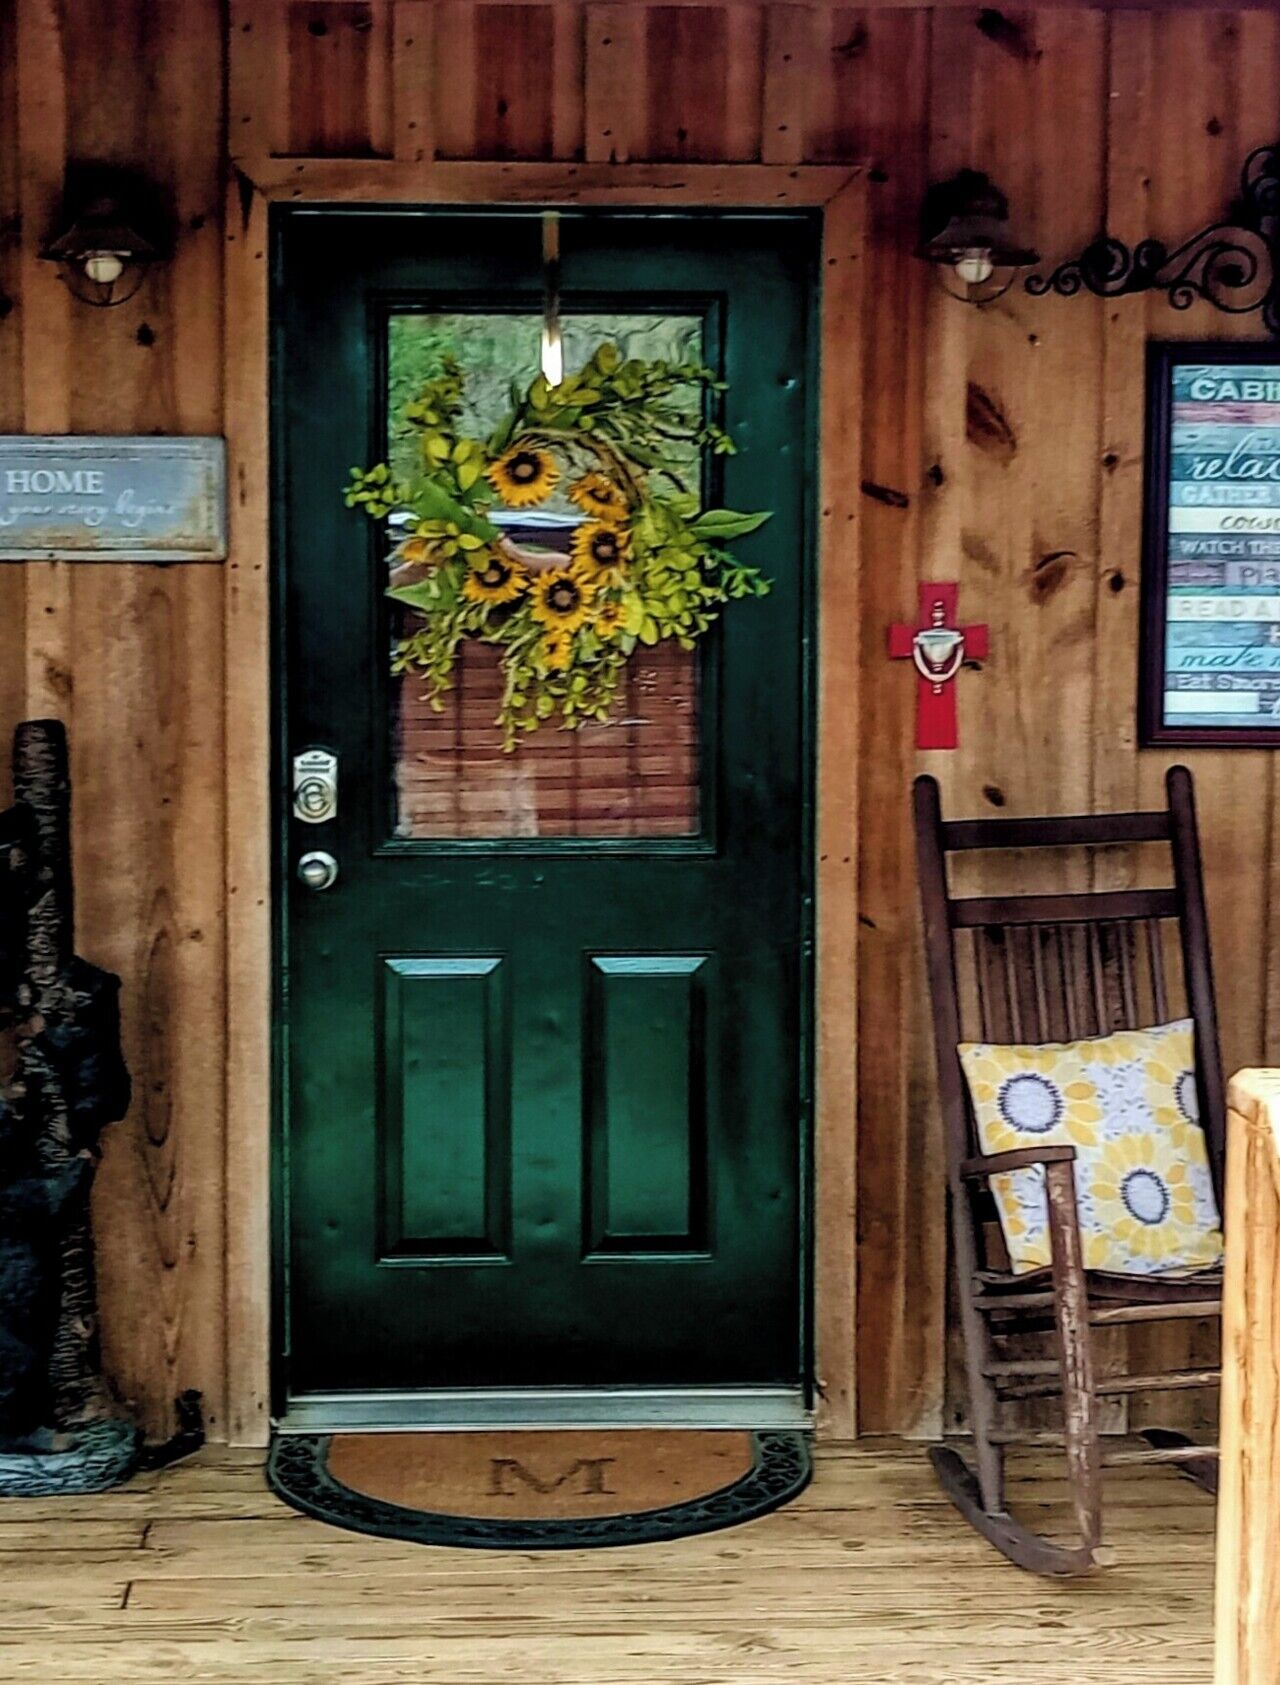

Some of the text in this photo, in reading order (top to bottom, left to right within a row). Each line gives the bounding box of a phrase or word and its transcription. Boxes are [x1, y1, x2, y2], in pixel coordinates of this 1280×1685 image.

[5, 469, 105, 495] HOME
[1181, 485, 1272, 503] GATHER
[57, 503, 108, 527] story
[1179, 540, 1245, 555] WATCH
[1177, 600, 1244, 617] READ
[1252, 600, 1271, 617] A
[1181, 645, 1262, 667] make
[1175, 673, 1214, 690] Eat
[484, 1458, 617, 1496] M
